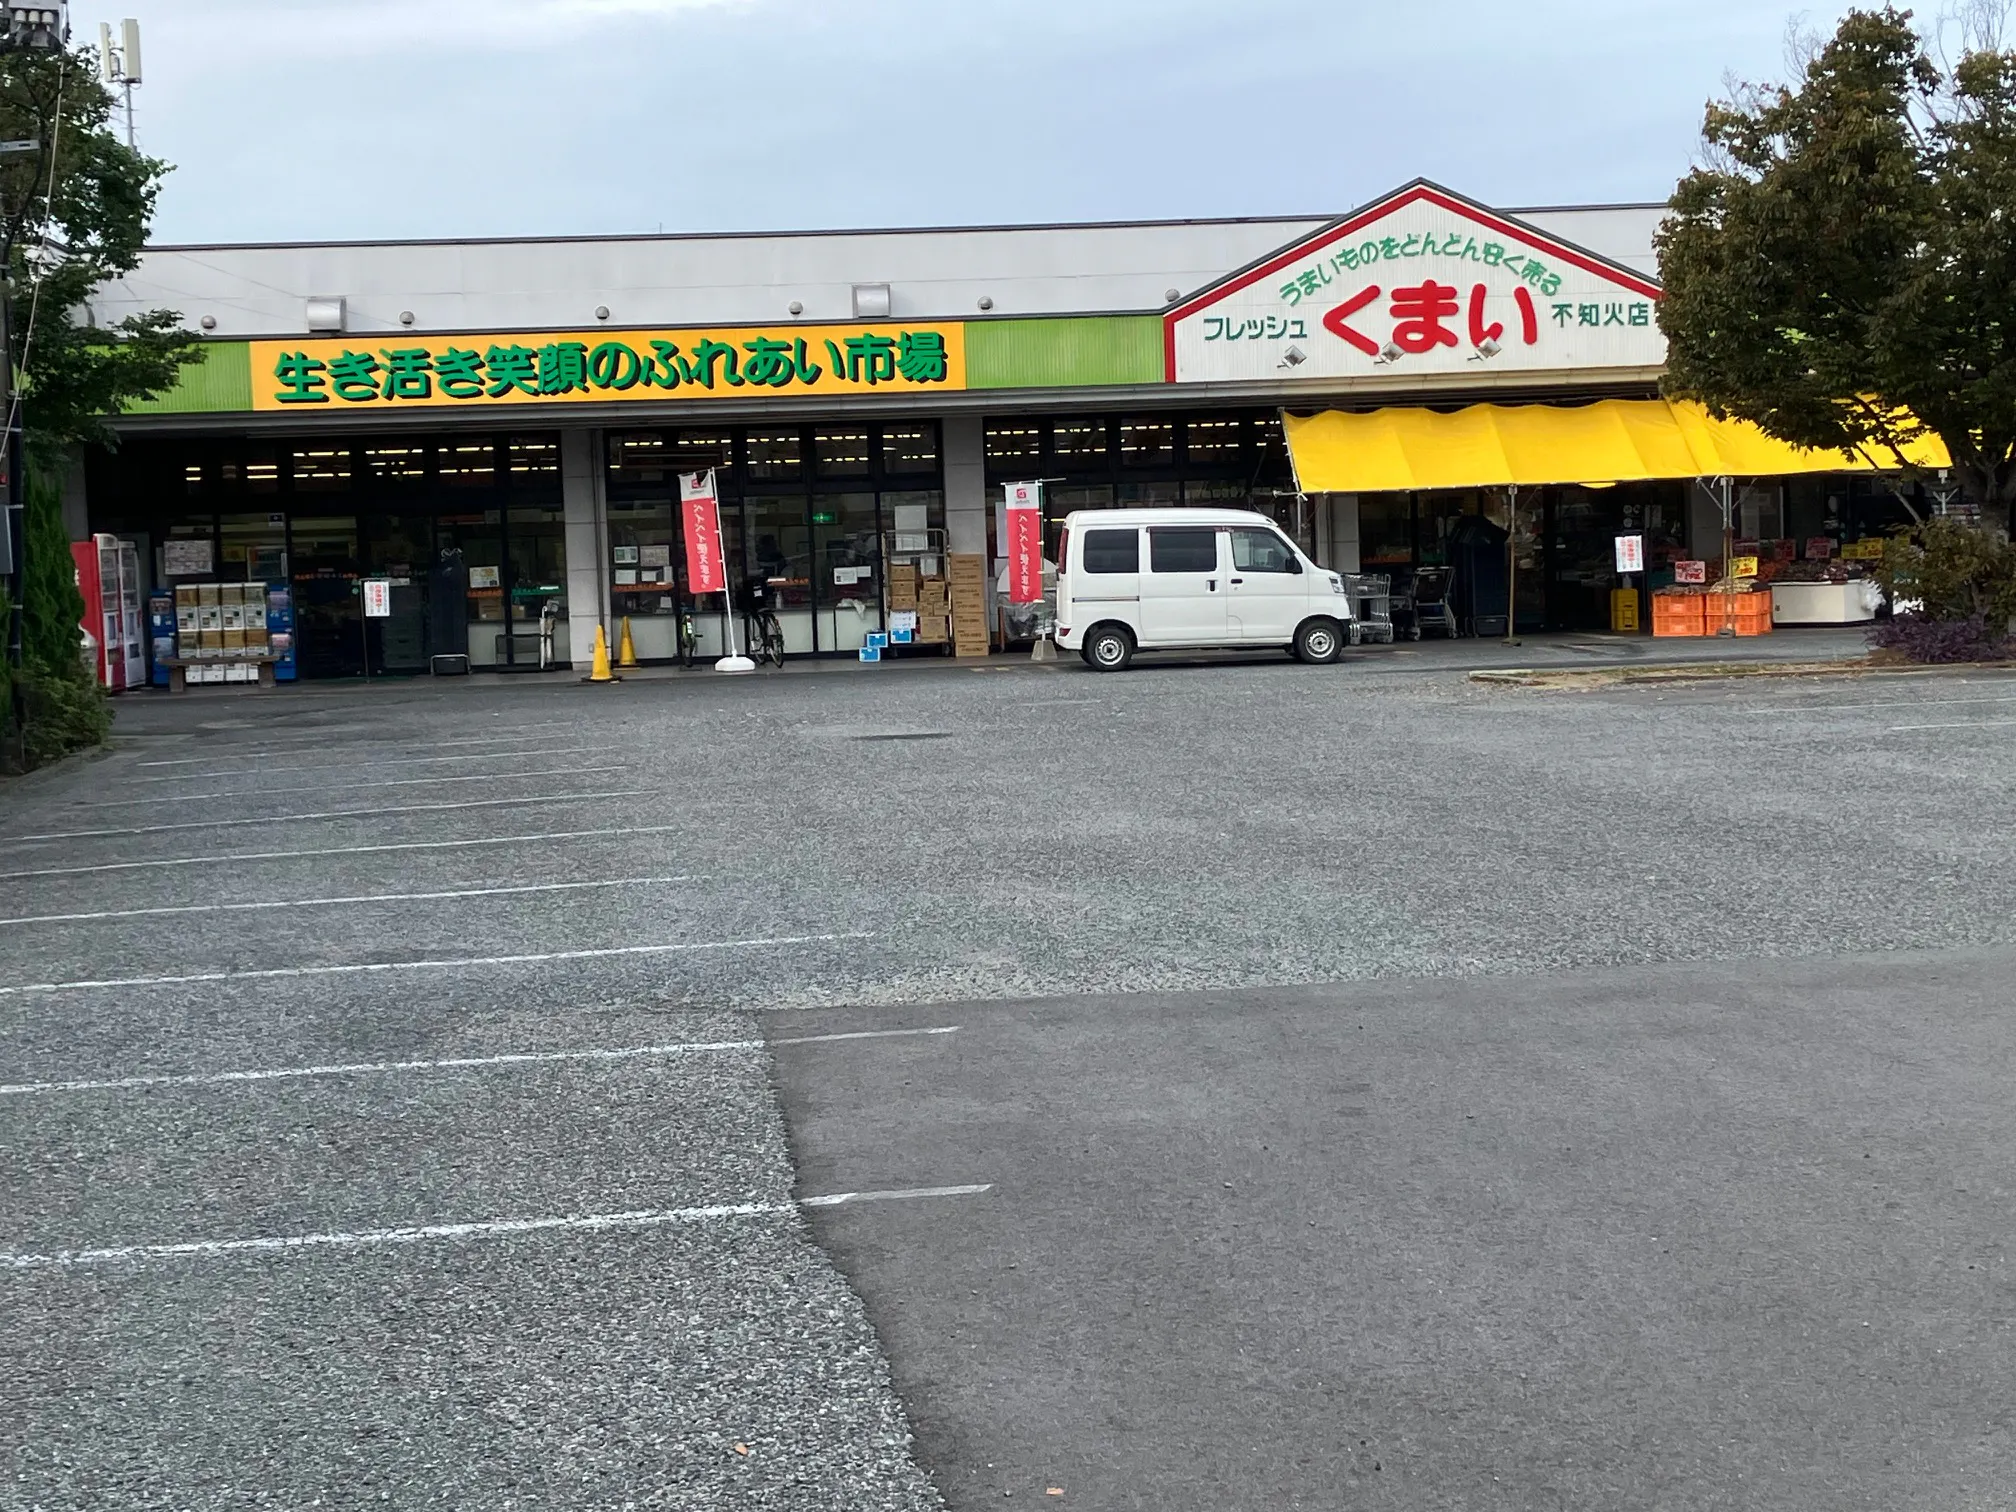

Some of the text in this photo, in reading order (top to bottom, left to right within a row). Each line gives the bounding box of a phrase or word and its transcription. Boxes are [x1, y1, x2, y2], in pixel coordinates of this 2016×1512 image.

[1280, 232, 1562, 307] うまいものをどんどん安く売る
[1204, 317, 1307, 341] フレッシュ
[1322, 279, 1538, 355] くまい
[1552, 302, 1649, 328] 不知火店
[275, 332, 945, 402] 生き活き笑顔のふれあい市場
